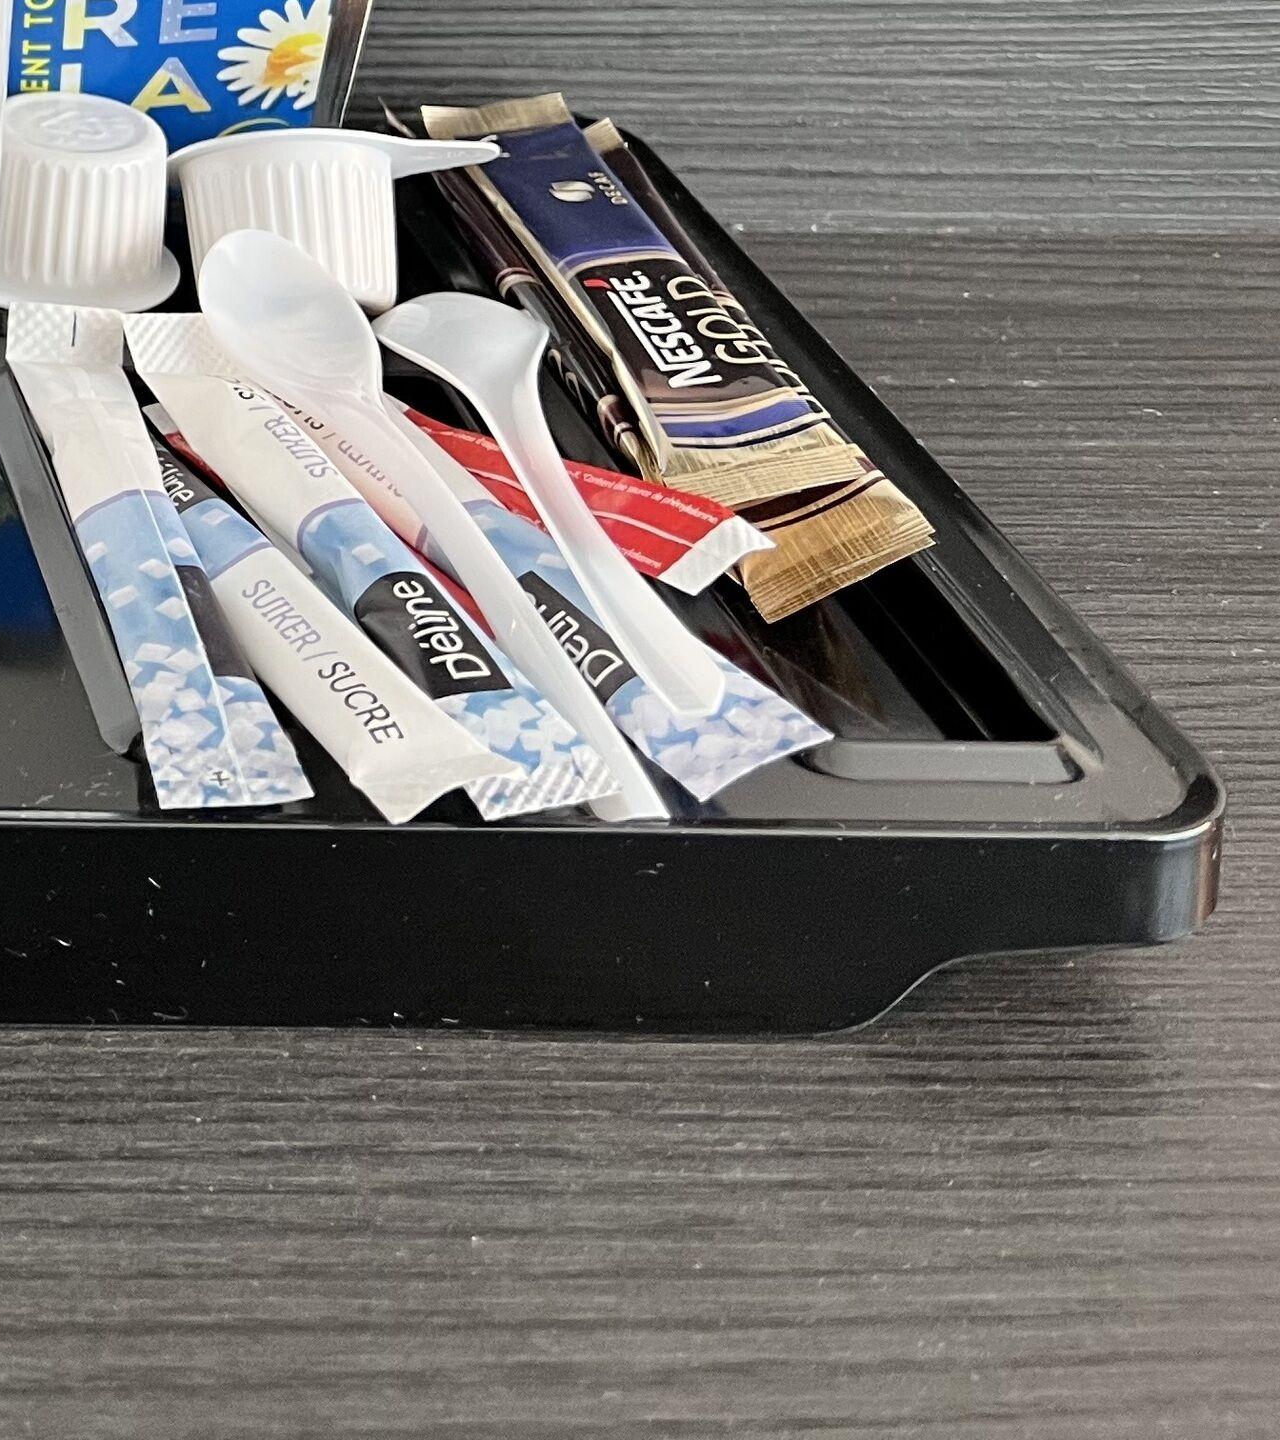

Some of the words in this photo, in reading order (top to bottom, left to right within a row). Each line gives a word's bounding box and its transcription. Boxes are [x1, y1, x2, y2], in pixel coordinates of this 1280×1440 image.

[19, 39, 52, 92] ENT
[666, 275, 769, 365] GOLD
[263, 415, 338, 480] SUIKER
[240, 578, 321, 654] SUIKER
[317, 661, 405, 745] SUCRE
[392, 579, 492, 681] Déline
